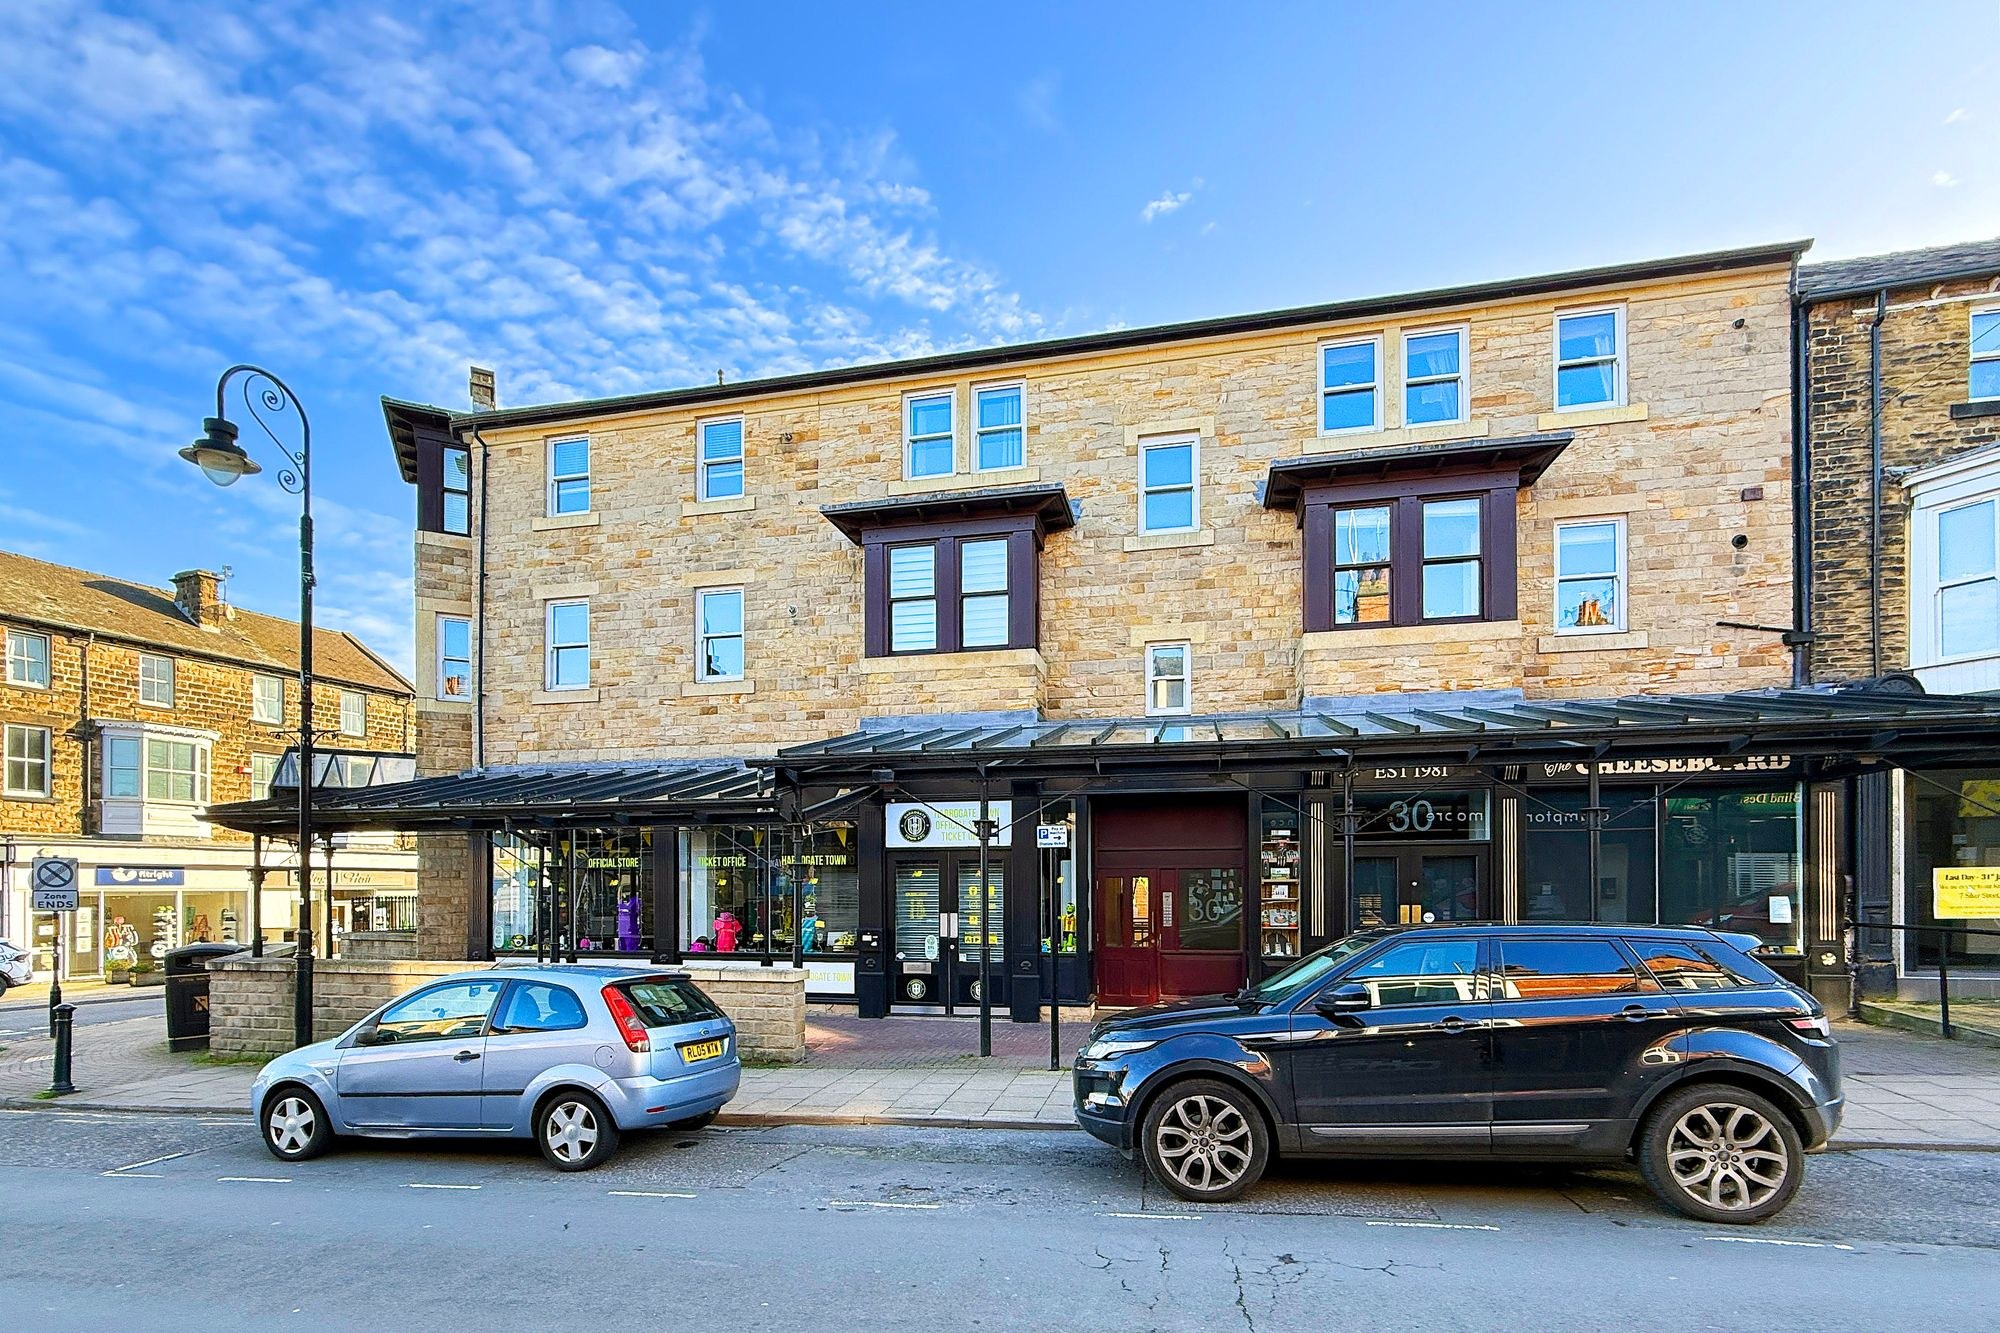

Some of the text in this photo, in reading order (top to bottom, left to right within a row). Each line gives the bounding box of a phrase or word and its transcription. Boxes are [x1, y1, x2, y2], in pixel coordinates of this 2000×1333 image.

[1374, 766, 1448, 779] EST 1981
[1544, 762, 1572, 778] The
[1389, 800, 1433, 832] 30
[941, 831, 967, 841] TICKET
[588, 857, 639, 868] OFFICIAL STORE
[697, 856, 747, 867] TICKET OFFICE
[825, 855, 847, 866] TOWN
[37, 901, 74, 909] ENDS
